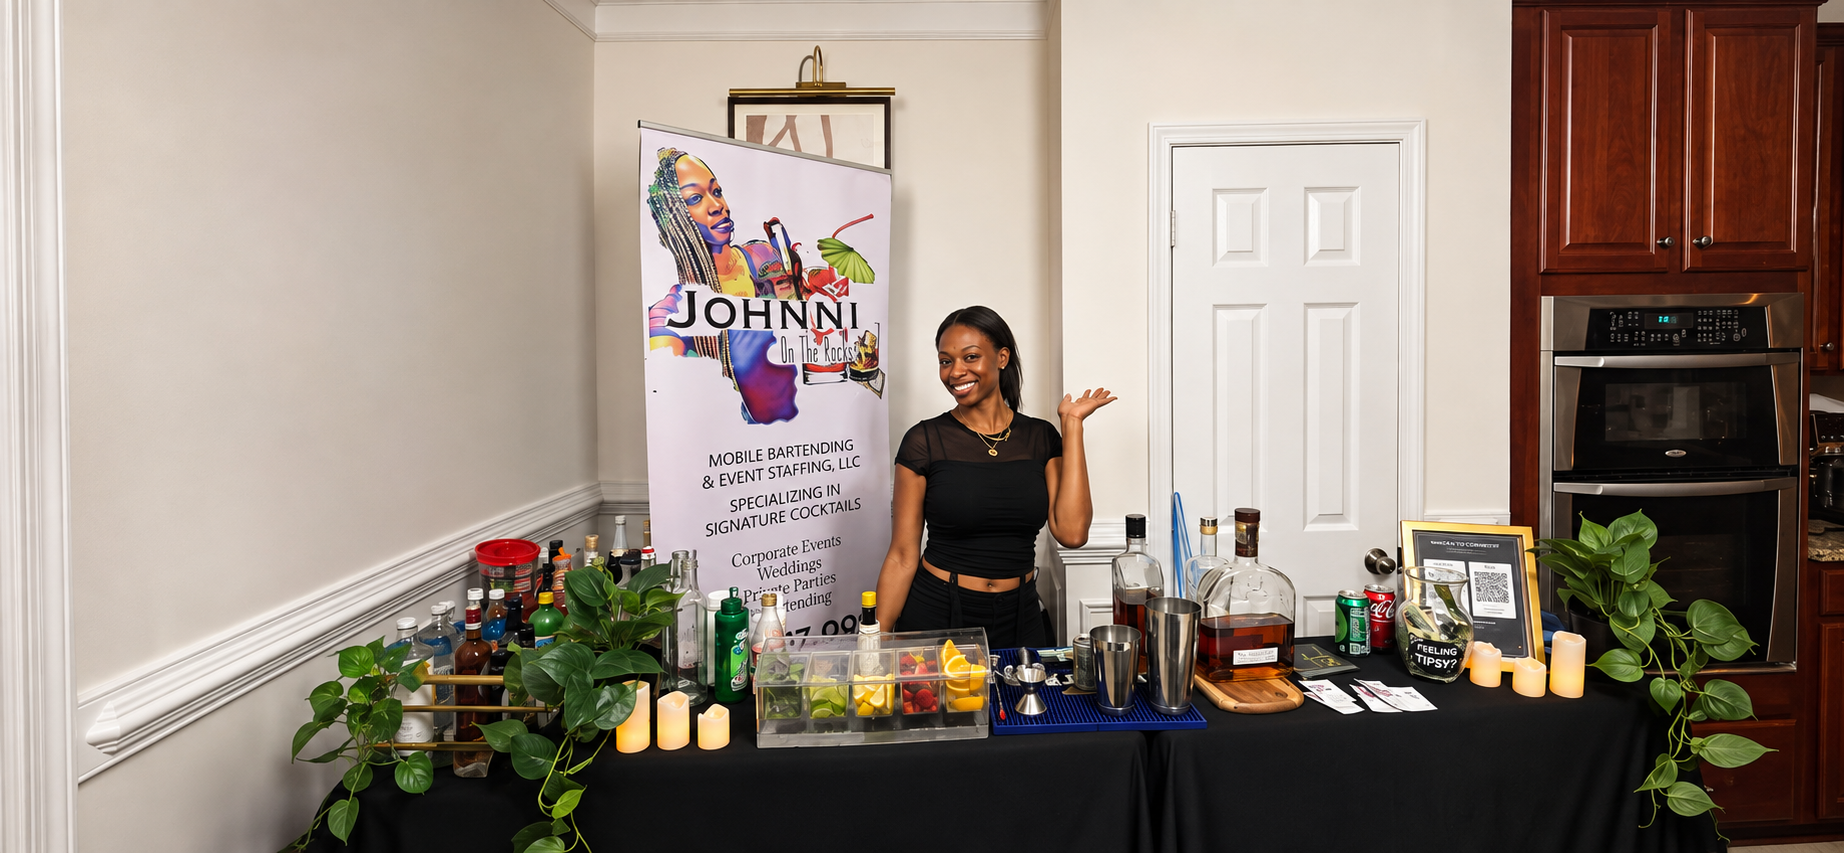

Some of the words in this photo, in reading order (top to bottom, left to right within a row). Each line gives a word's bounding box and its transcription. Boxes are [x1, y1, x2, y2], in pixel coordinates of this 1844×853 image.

[666, 290, 859, 330] JOHNNI
[780, 335, 794, 363] On
[799, 334, 818, 363] The
[709, 449, 763, 468] MOBILE
[768, 439, 854, 460] BARTENDING
[702, 475, 715, 490] &
[719, 468, 764, 487] EVENT
[768, 459, 835, 480] STAFFING,
[838, 455, 861, 470] LLC
[730, 486, 822, 513] SPECIALIZING
[827, 483, 841, 497] IN
[705, 510, 786, 537] SIGNATURE
[790, 498, 861, 521] COCKTAILS
[732, 546, 798, 568] Corporate
[802, 535, 842, 554] Events
[757, 558, 822, 581] Weddings
[743, 584, 790, 605] Priate
[794, 573, 837, 593] Parties
[1415, 653, 1457, 669] TIPSY?
[1417, 643, 1458, 656] FEELING
